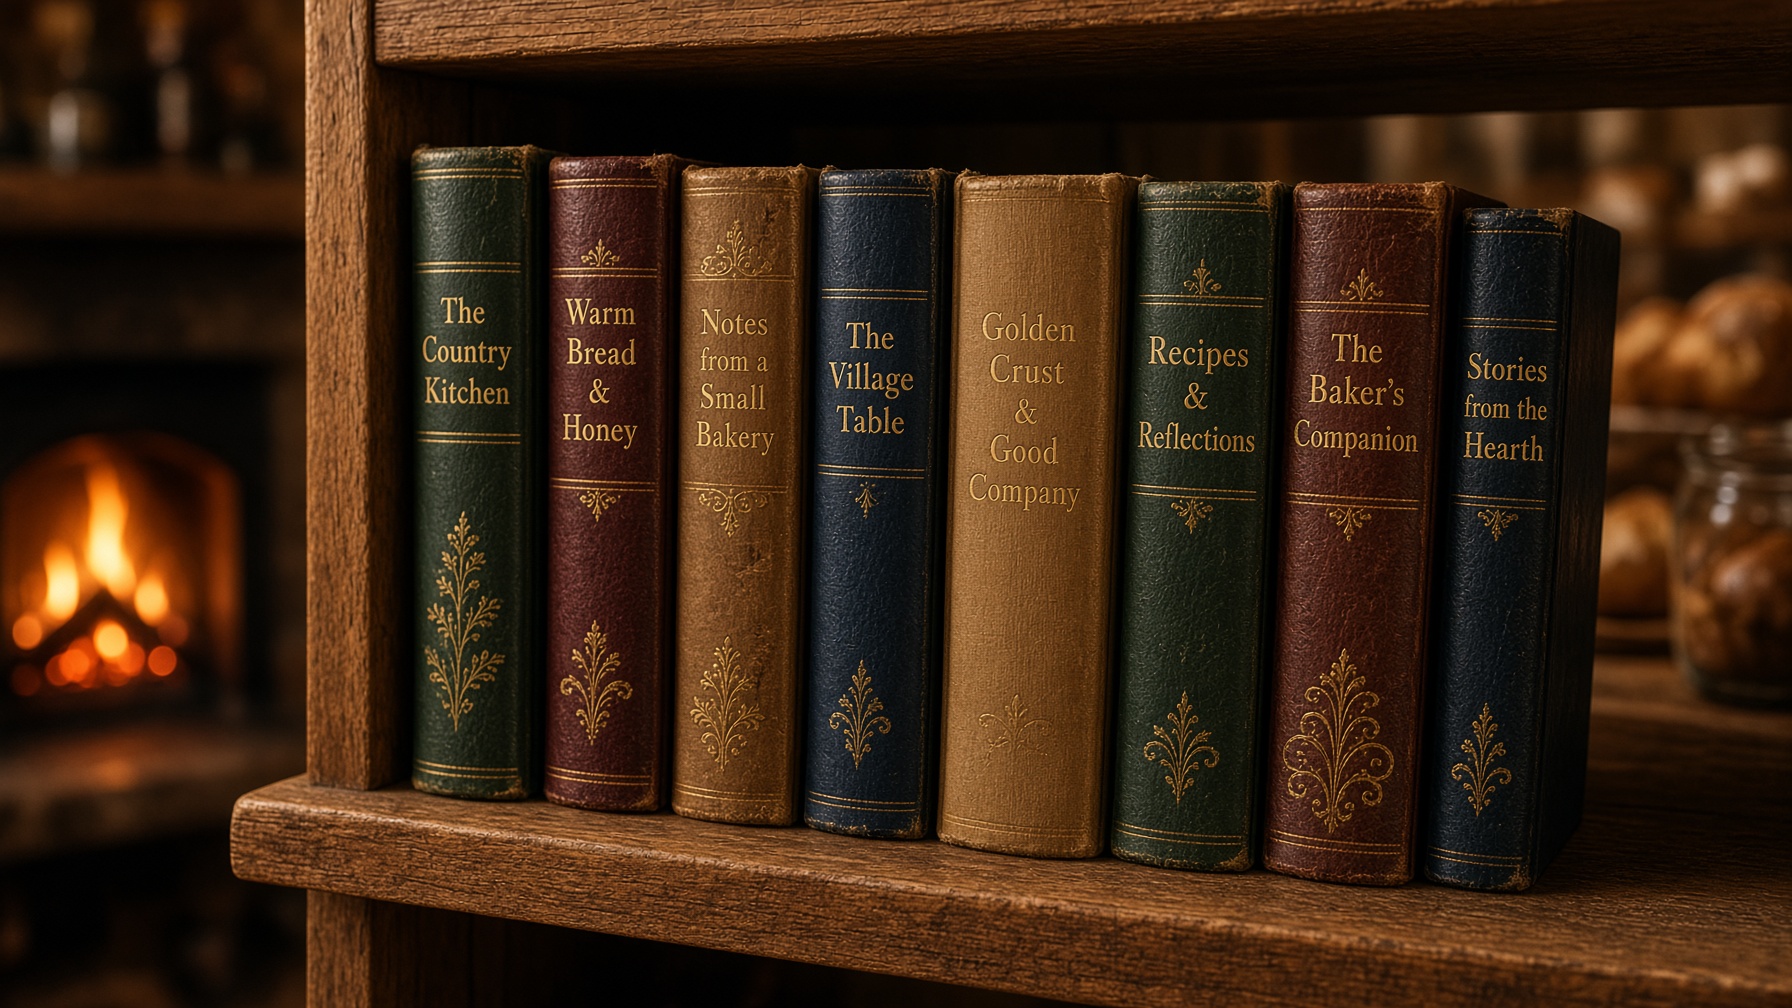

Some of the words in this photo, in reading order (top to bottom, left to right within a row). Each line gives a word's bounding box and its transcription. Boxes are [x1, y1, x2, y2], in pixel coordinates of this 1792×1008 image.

[440, 297, 485, 324] The
[565, 298, 636, 326] Warm
[700, 308, 769, 336] Notes
[845, 322, 895, 350] The
[982, 311, 1076, 342] Golden
[422, 335, 512, 371] Country
[566, 338, 637, 366] Bread
[700, 347, 749, 372] from
[756, 355, 769, 373] a
[1148, 335, 1249, 375] Recipes
[1331, 333, 1383, 364] The
[828, 361, 914, 400] Village
[990, 354, 1065, 385] Crust
[1467, 352, 1548, 383] Stories
[424, 376, 511, 406] Kitchen
[588, 378, 610, 404] &
[700, 383, 766, 410] Small
[1183, 382, 1208, 410] &
[1308, 374, 1405, 407] Baker’s
[836, 405, 905, 435] Table
[1014, 398, 1038, 425] &
[1464, 394, 1511, 420] from
[1517, 396, 1548, 421] the
[562, 413, 638, 449] Honey
[695, 421, 775, 455] Bakery
[1138, 421, 1256, 453] Reflections
[1293, 419, 1419, 458] Companion
[1463, 431, 1544, 462] Hearth
[990, 434, 1059, 465] Good
[968, 473, 1080, 512] Company
